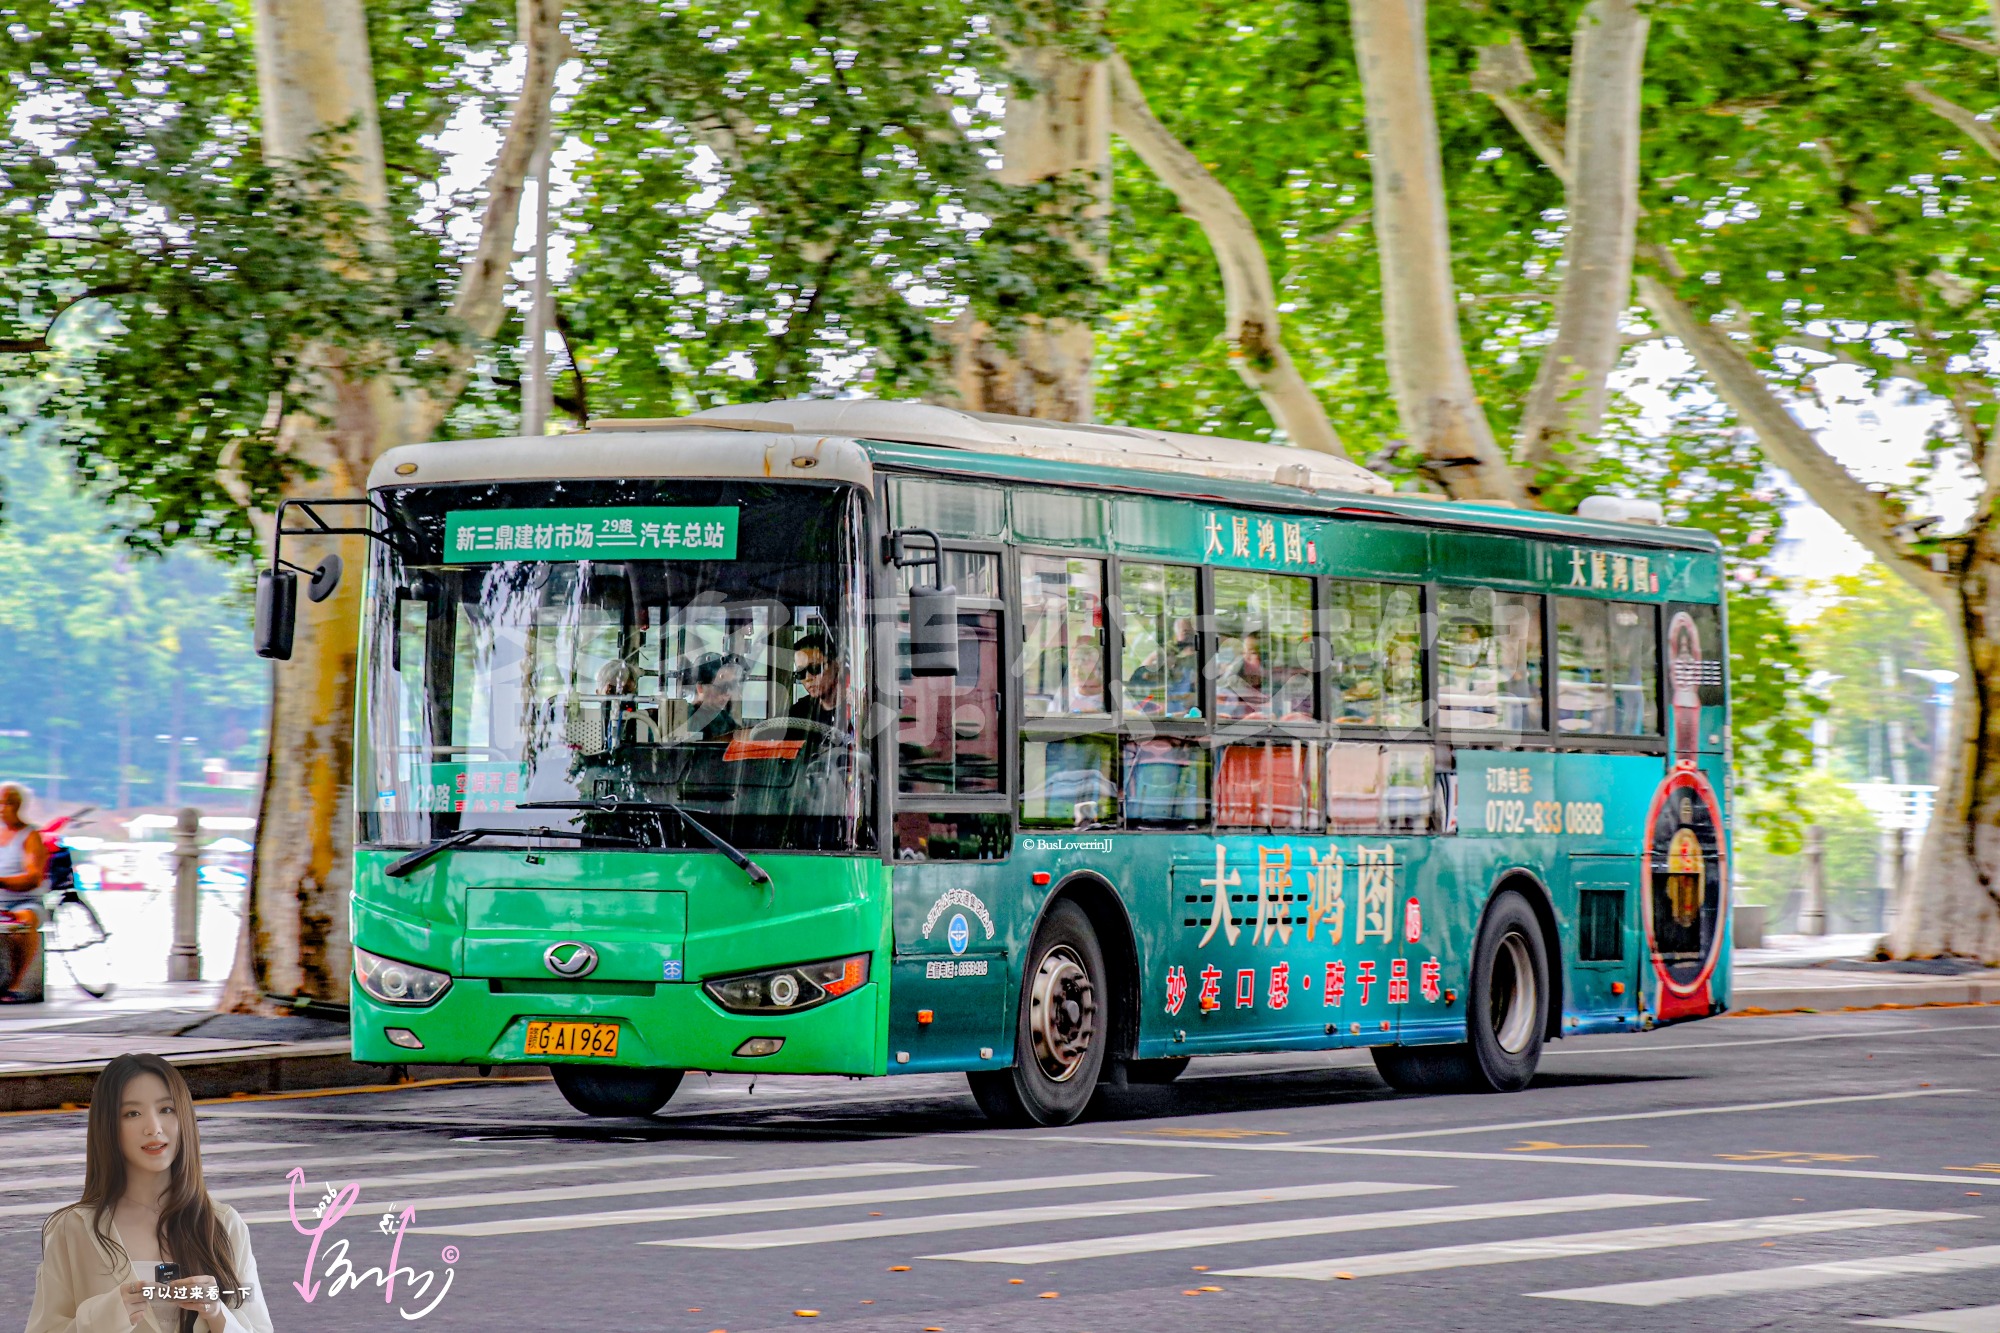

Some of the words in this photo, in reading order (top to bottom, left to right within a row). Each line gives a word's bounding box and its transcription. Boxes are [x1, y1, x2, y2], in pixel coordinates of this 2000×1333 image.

[455, 522, 594, 551] 新三鼎建材市场
[601, 518, 633, 534] 29路
[639, 521, 725, 549] 汽车总站
[1204, 512, 1303, 564] 大展鸿图
[1198, 843, 1395, 948] 大展鸿图
